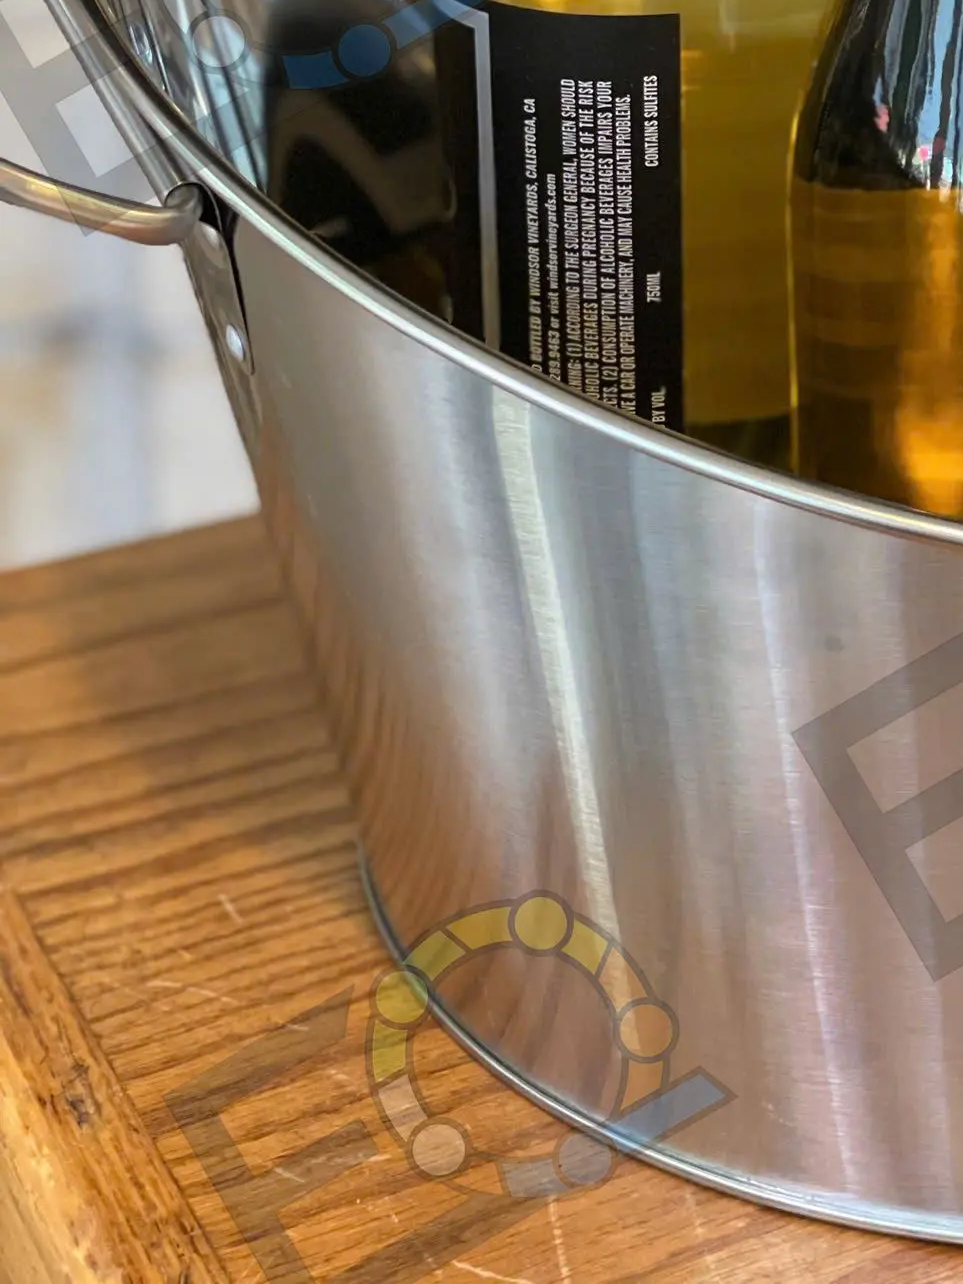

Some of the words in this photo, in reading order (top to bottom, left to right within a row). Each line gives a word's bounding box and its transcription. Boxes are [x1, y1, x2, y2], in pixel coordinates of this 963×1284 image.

[524, 98, 536, 113] CA
[560, 79, 576, 118] SHOULD
[578, 80, 593, 105] RISK
[597, 81, 612, 108] YOUR
[644, 75, 658, 117] SULFITES
[579, 109, 594, 127] THE
[597, 112, 613, 154] IMPAIRS
[616, 95, 631, 146] PROBLEMS.
[524, 117, 537, 179] CALISTOGA,
[562, 120, 576, 155] WOMEN
[580, 132, 594, 144] OF
[644, 120, 659, 167] CONTAINS
[562, 158, 578, 202] GENERAL,
[580, 148, 595, 194] BECAUSE
[616, 149, 632, 182] HEALTH
[598, 158, 614, 214] BEVERAGES
[617, 184, 632, 214] CAUSE
[526, 182, 539, 243] VINEYARDS,
[564, 205, 579, 250] SURGEON
[581, 196, 596, 256] PREGNANCY
[618, 217, 632, 236] MAY
[545, 174, 559, 289] windsorvineyards.com
[599, 218, 615, 273] ALCOHOLIC
[618, 238, 633, 256] AND
[528, 246, 541, 296] WINDSOR
[565, 251, 579, 268] THE
[565, 272, 580, 283] TO
[582, 261, 598, 299] DURING
[601, 277, 616, 289] OF
[618, 259, 635, 314] MACHINERY,
[647, 272, 661, 302] 750ML
[529, 298, 541, 314] BY
[548, 292, 559, 314] visit
[566, 286, 580, 341] ACCORDING
[529, 316, 542, 362] BOTTLED
[550, 317, 560, 328] or
[583, 302, 599, 359] BEVERAGES
[601, 293, 617, 363] CONSUMPTION
[619, 316, 636, 354] OPERATE
[566, 343, 582, 356] (1)
[620, 356, 636, 369] OR
[601, 366, 618, 380] (2)
[620, 372, 636, 390] CAR
[603, 384, 618, 408] CTS.
[652, 410, 666, 422] BY
